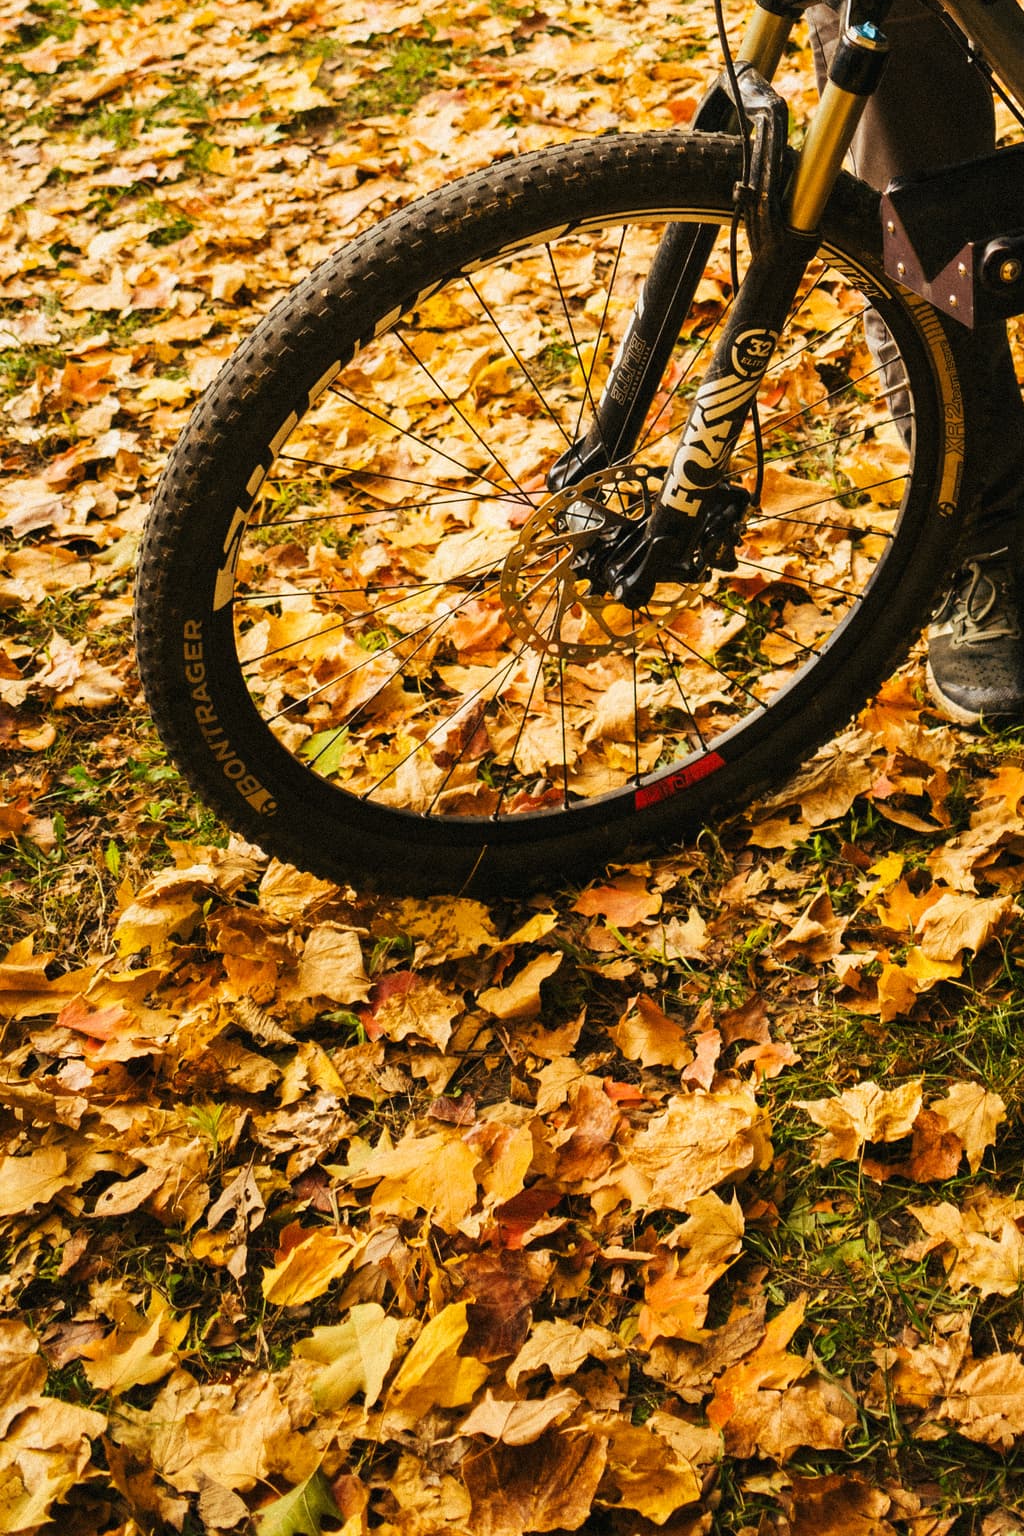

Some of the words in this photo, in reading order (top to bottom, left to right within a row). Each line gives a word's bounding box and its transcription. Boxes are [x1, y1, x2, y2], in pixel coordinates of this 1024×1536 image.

[610, 330, 647, 405] ELITE
[746, 337, 773, 357] 32
[660, 402, 735, 518] FOX
[183, 618, 263, 797] BONTRAGER
